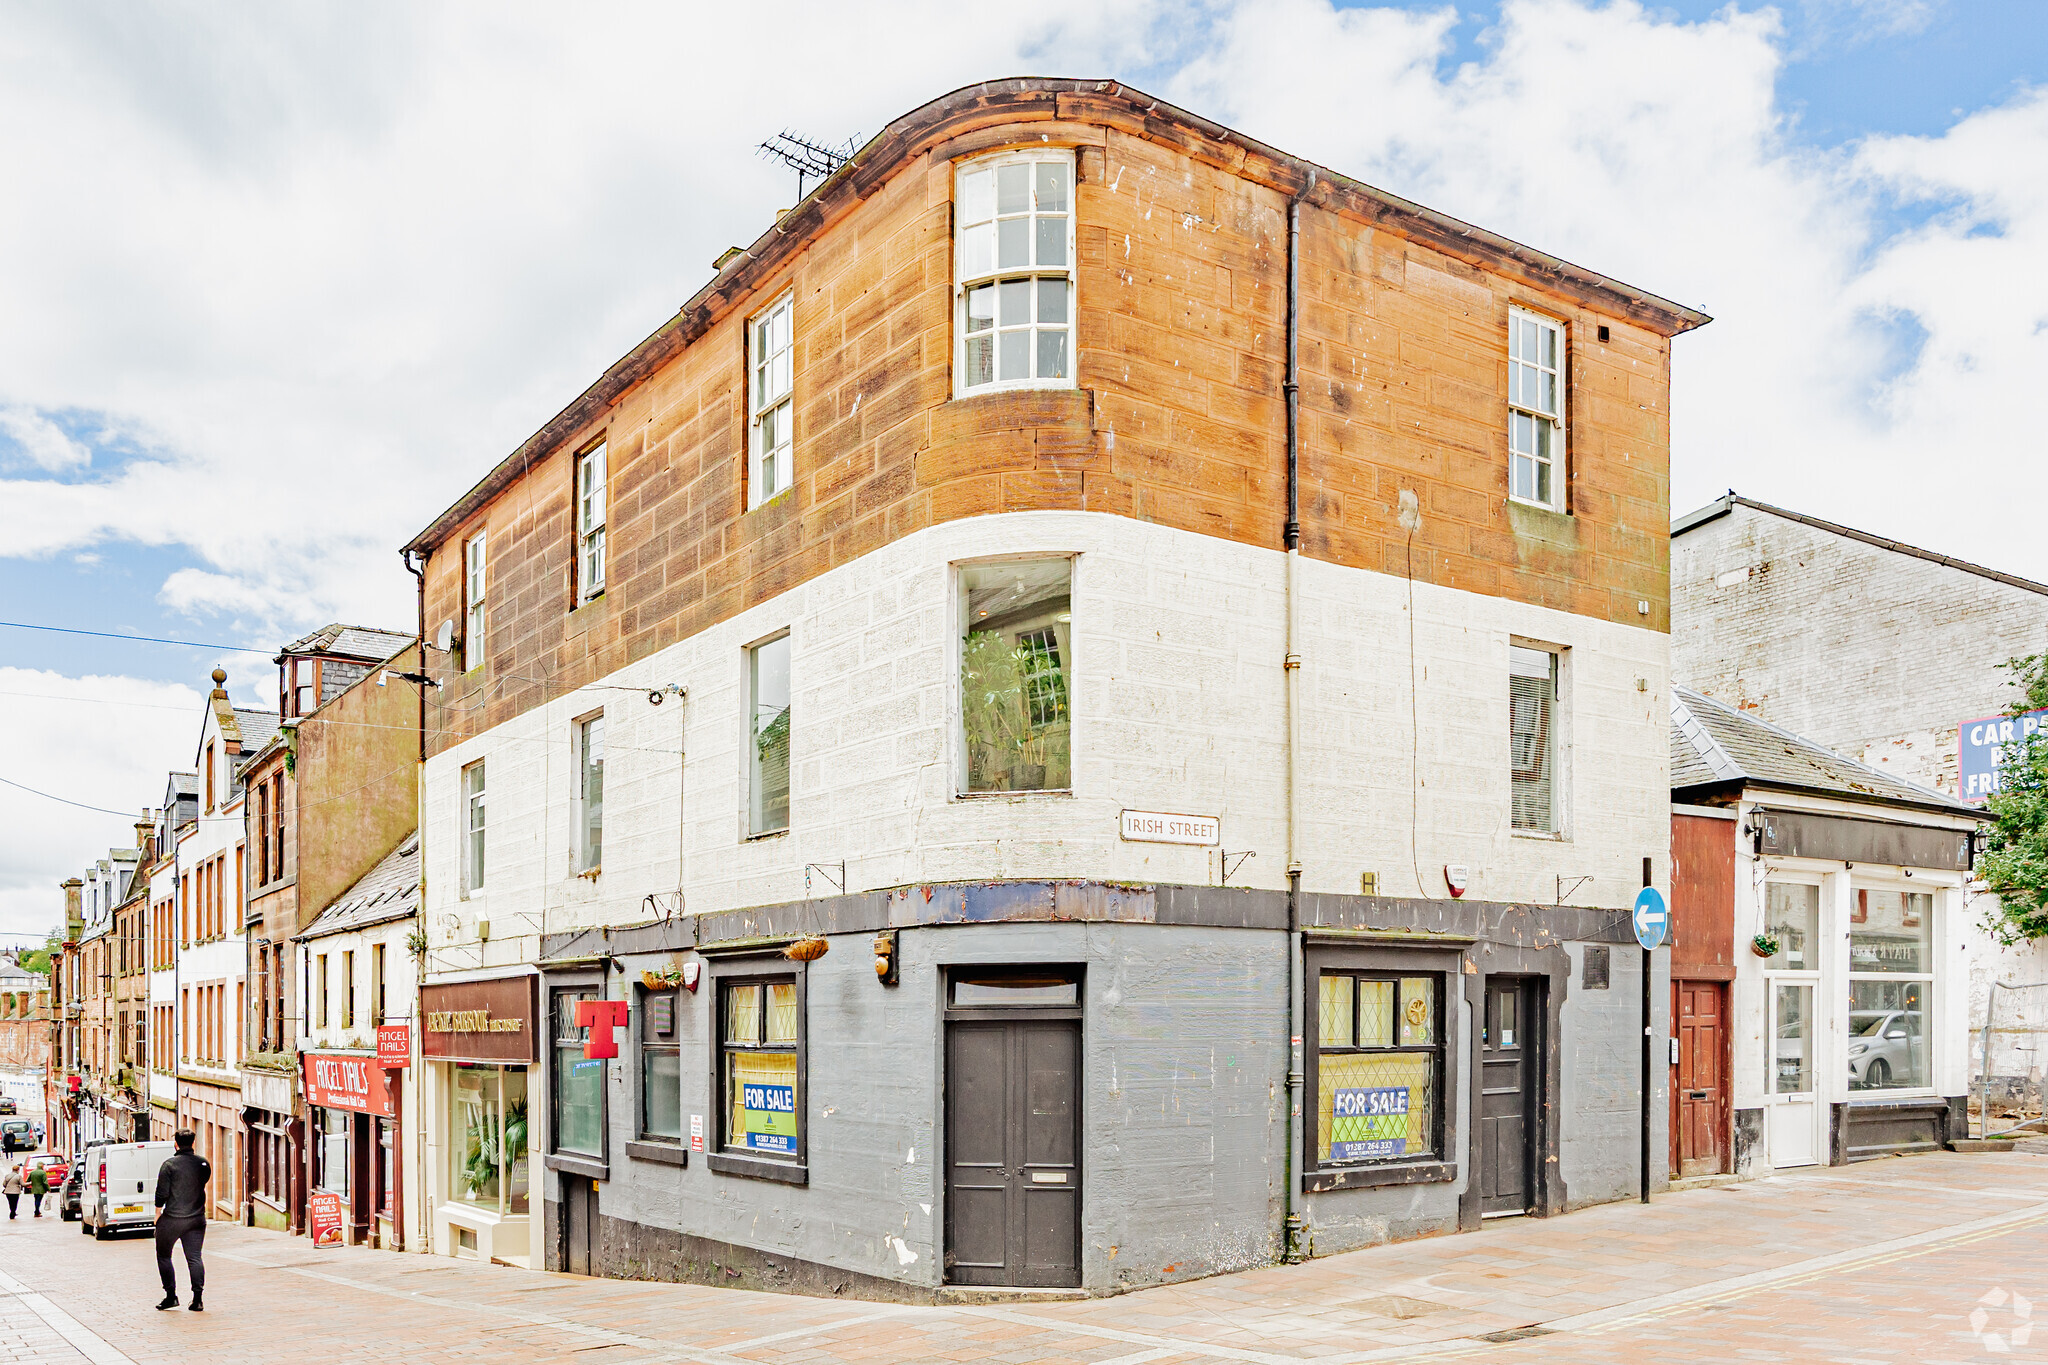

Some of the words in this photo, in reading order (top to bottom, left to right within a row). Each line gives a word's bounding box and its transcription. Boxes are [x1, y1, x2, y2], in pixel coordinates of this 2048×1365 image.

[1970, 721, 2014, 746] CAR
[1128, 818, 1163, 834] IRISH
[1170, 822, 1214, 838] STREET
[379, 1032, 407, 1040] ANGEL
[380, 1042, 406, 1051] NAILS
[316, 1060, 344, 1091] ANGEL
[342, 1061, 368, 1094] NAILS
[745, 1088, 765, 1108] FOR
[766, 1089, 792, 1110] SALE
[1336, 1093, 1366, 1115] FOR
[1370, 1092, 1406, 1114] SALE
[1346, 1143, 1365, 1151] 01387
[1380, 1141, 1392, 1149] 333
[312, 1196, 337, 1206] ANGEL
[316, 1205, 336, 1213] NAILS
